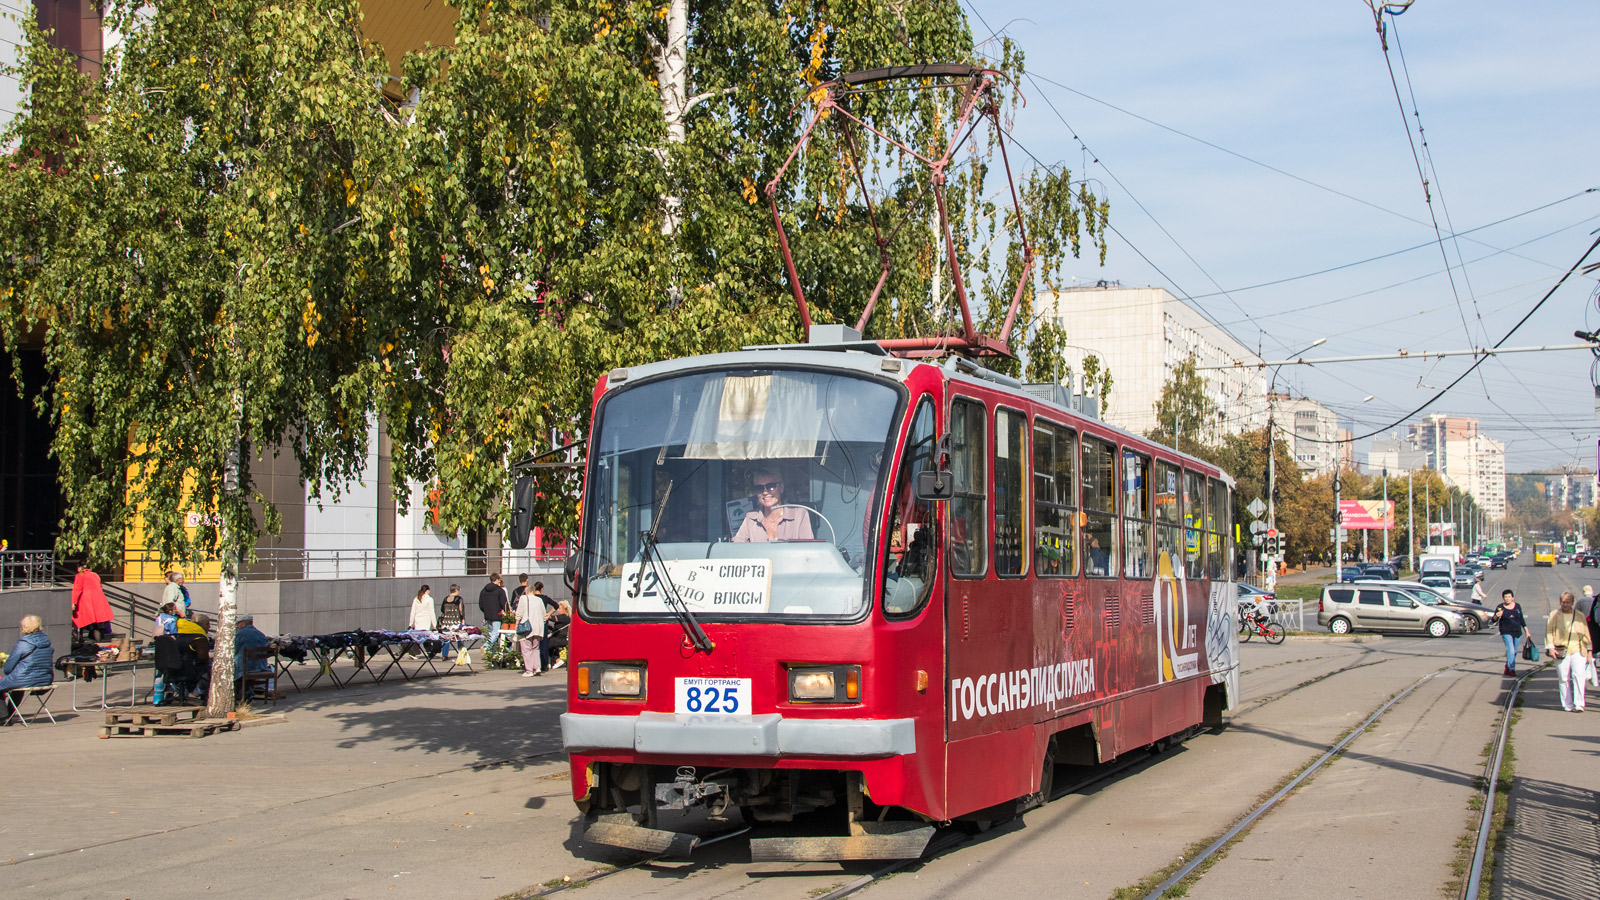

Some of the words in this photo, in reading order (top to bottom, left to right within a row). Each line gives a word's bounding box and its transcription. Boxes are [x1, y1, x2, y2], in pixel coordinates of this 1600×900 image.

[627, 571, 659, 599] 32
[687, 570, 698, 582] В
[713, 591, 762, 605] ВЛКСМ
[1188, 624, 1197, 648] ЛЕТ
[686, 686, 739, 714] 825
[951, 658, 1096, 722] ГОССАНЭПИДСЛУЖБА
